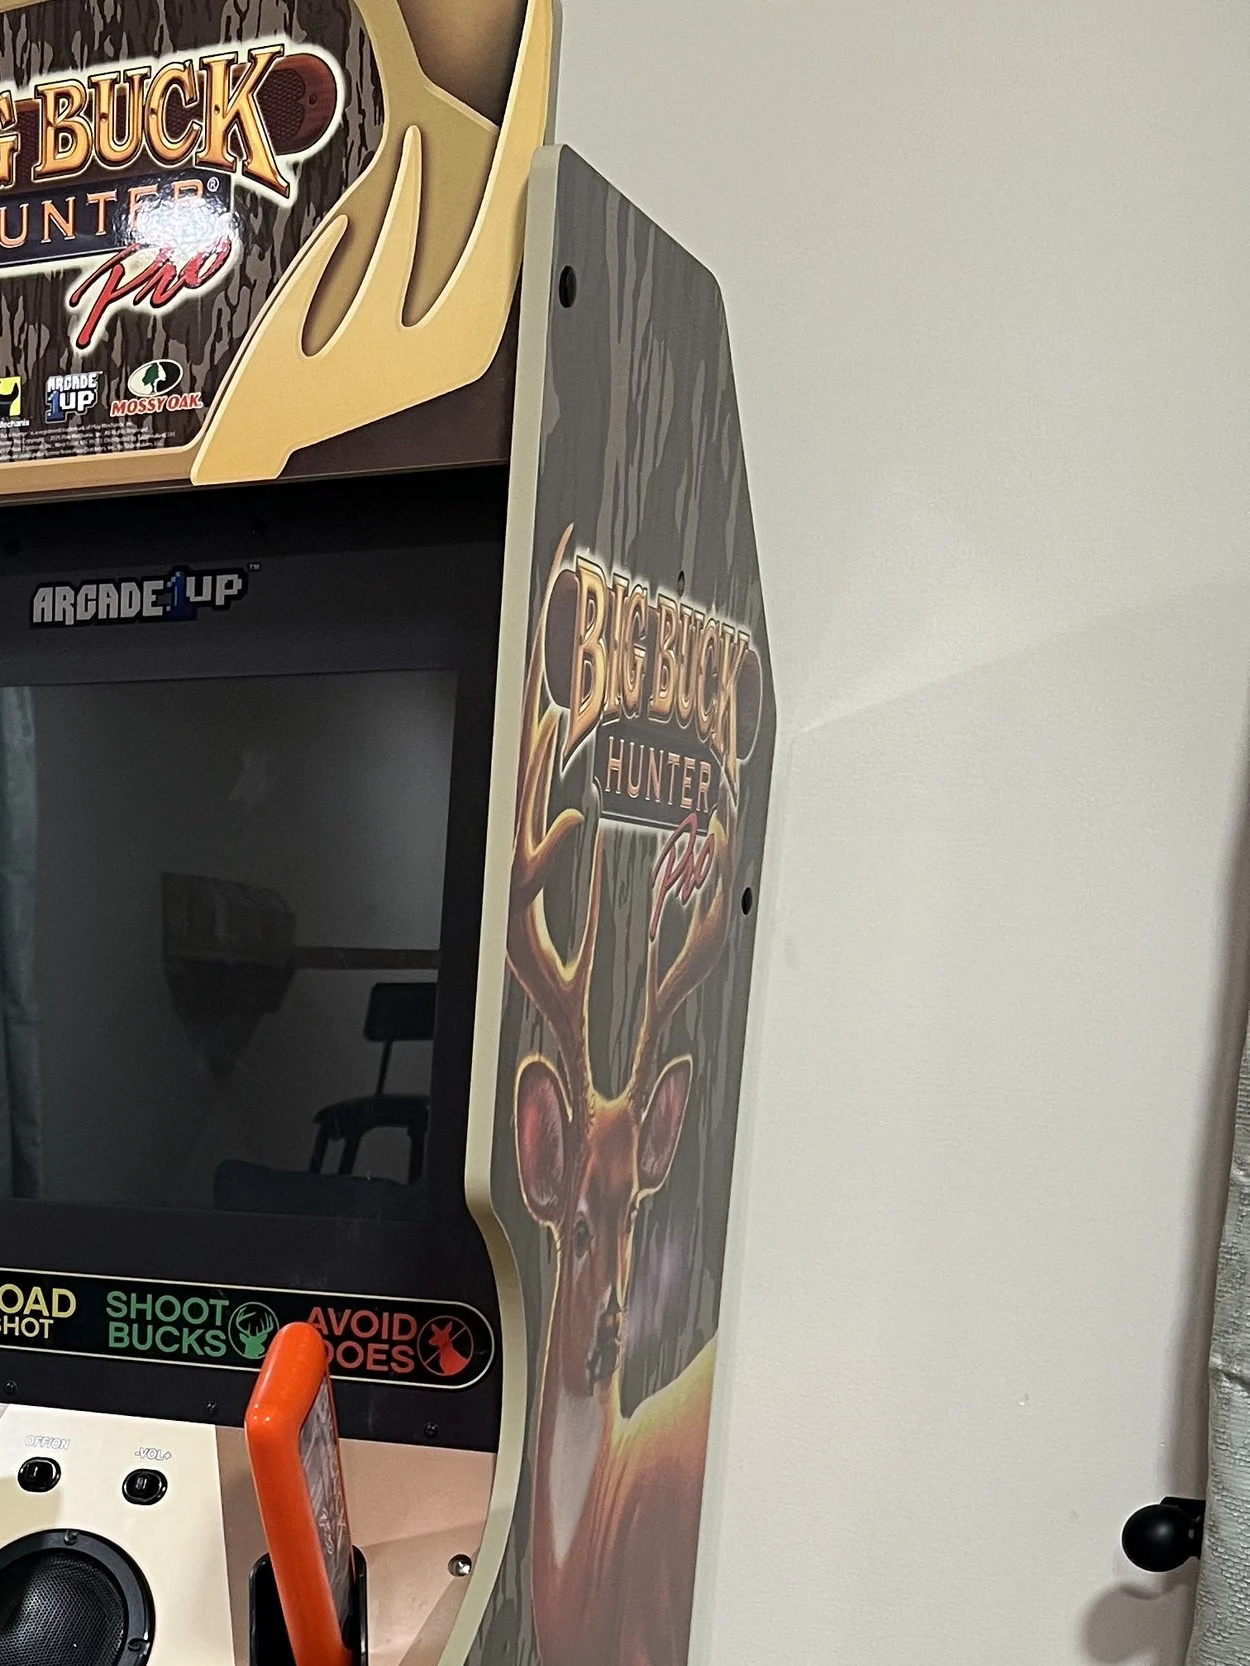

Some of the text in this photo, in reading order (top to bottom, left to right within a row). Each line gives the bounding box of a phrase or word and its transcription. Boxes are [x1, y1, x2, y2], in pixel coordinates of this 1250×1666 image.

[33, 44, 290, 198] BUCK
[69, 238, 232, 349] Pro
[47, 372, 97, 391] ARCADE
[46, 387, 98, 421] 1UP
[110, 392, 203, 417] MOSSY OAK
[562, 555, 751, 803] BIG BUCK
[605, 736, 712, 814] HUNTER
[650, 812, 715, 941] Pro
[106, 1291, 230, 1326] SHOOT
[307, 1306, 418, 1342] AVOID
[108, 1321, 227, 1357] BUCKS
